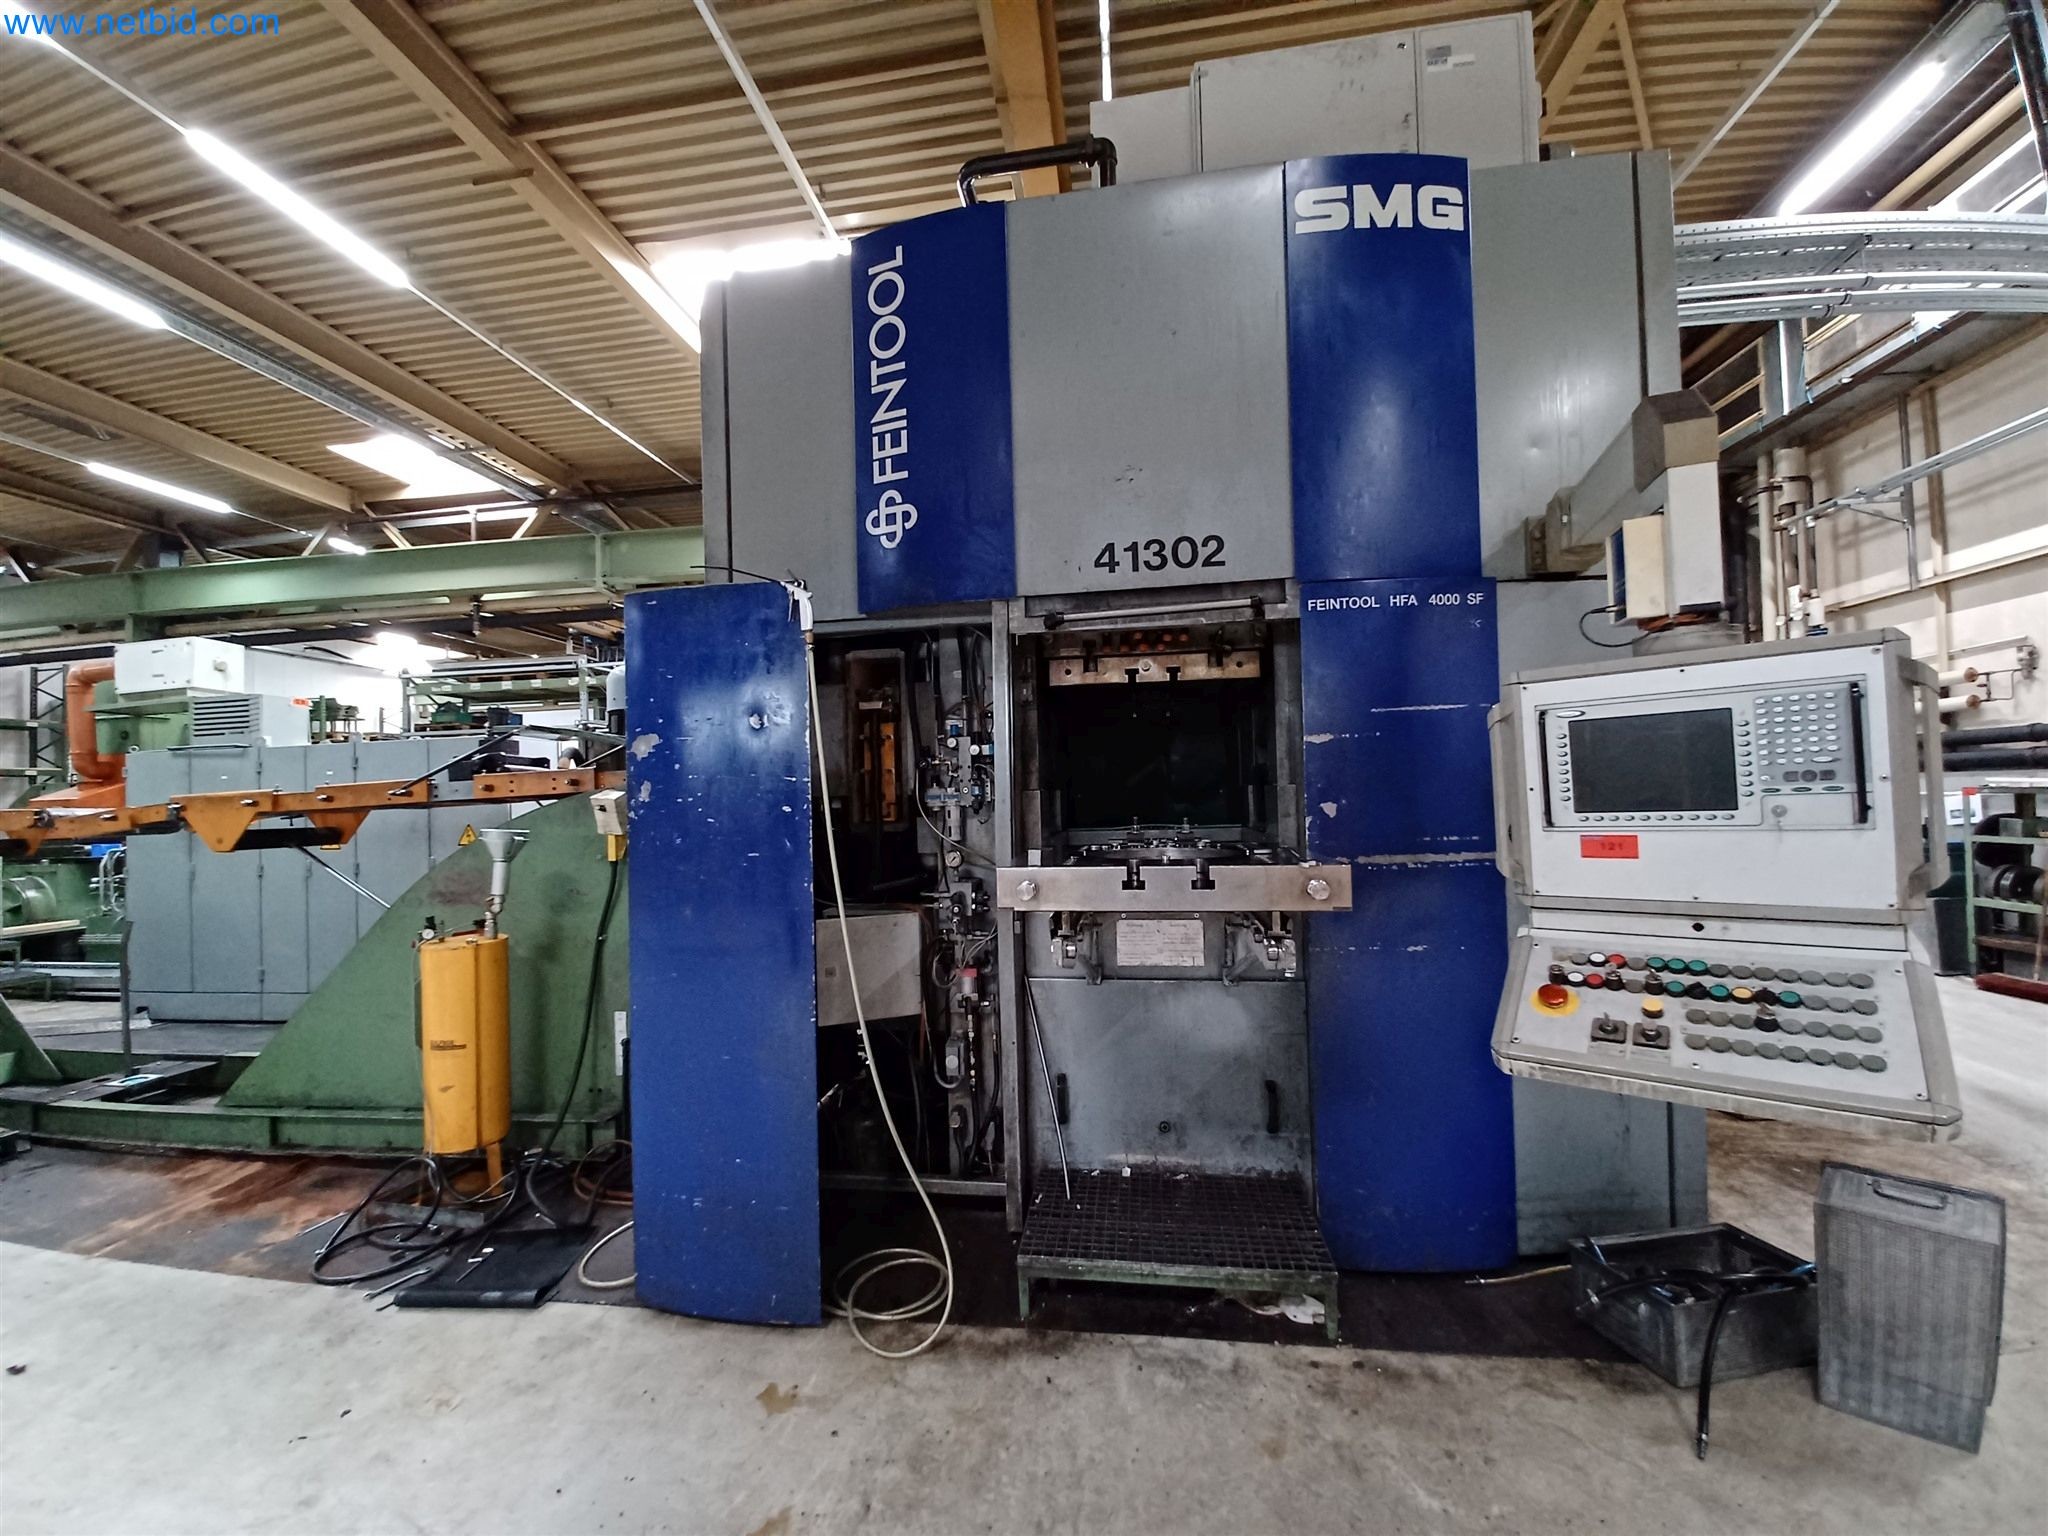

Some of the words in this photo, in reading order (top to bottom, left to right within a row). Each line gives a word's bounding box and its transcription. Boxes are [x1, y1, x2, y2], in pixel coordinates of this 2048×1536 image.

[1295, 183, 1465, 235] SMG
[868, 245, 909, 485] FEINTOOL
[1094, 534, 1226, 573] 41302
[1307, 596, 1380, 612] FEINTOOL
[1390, 594, 1418, 607] HFA
[1428, 593, 1461, 606] 4000
[1466, 592, 1485, 605] SF
